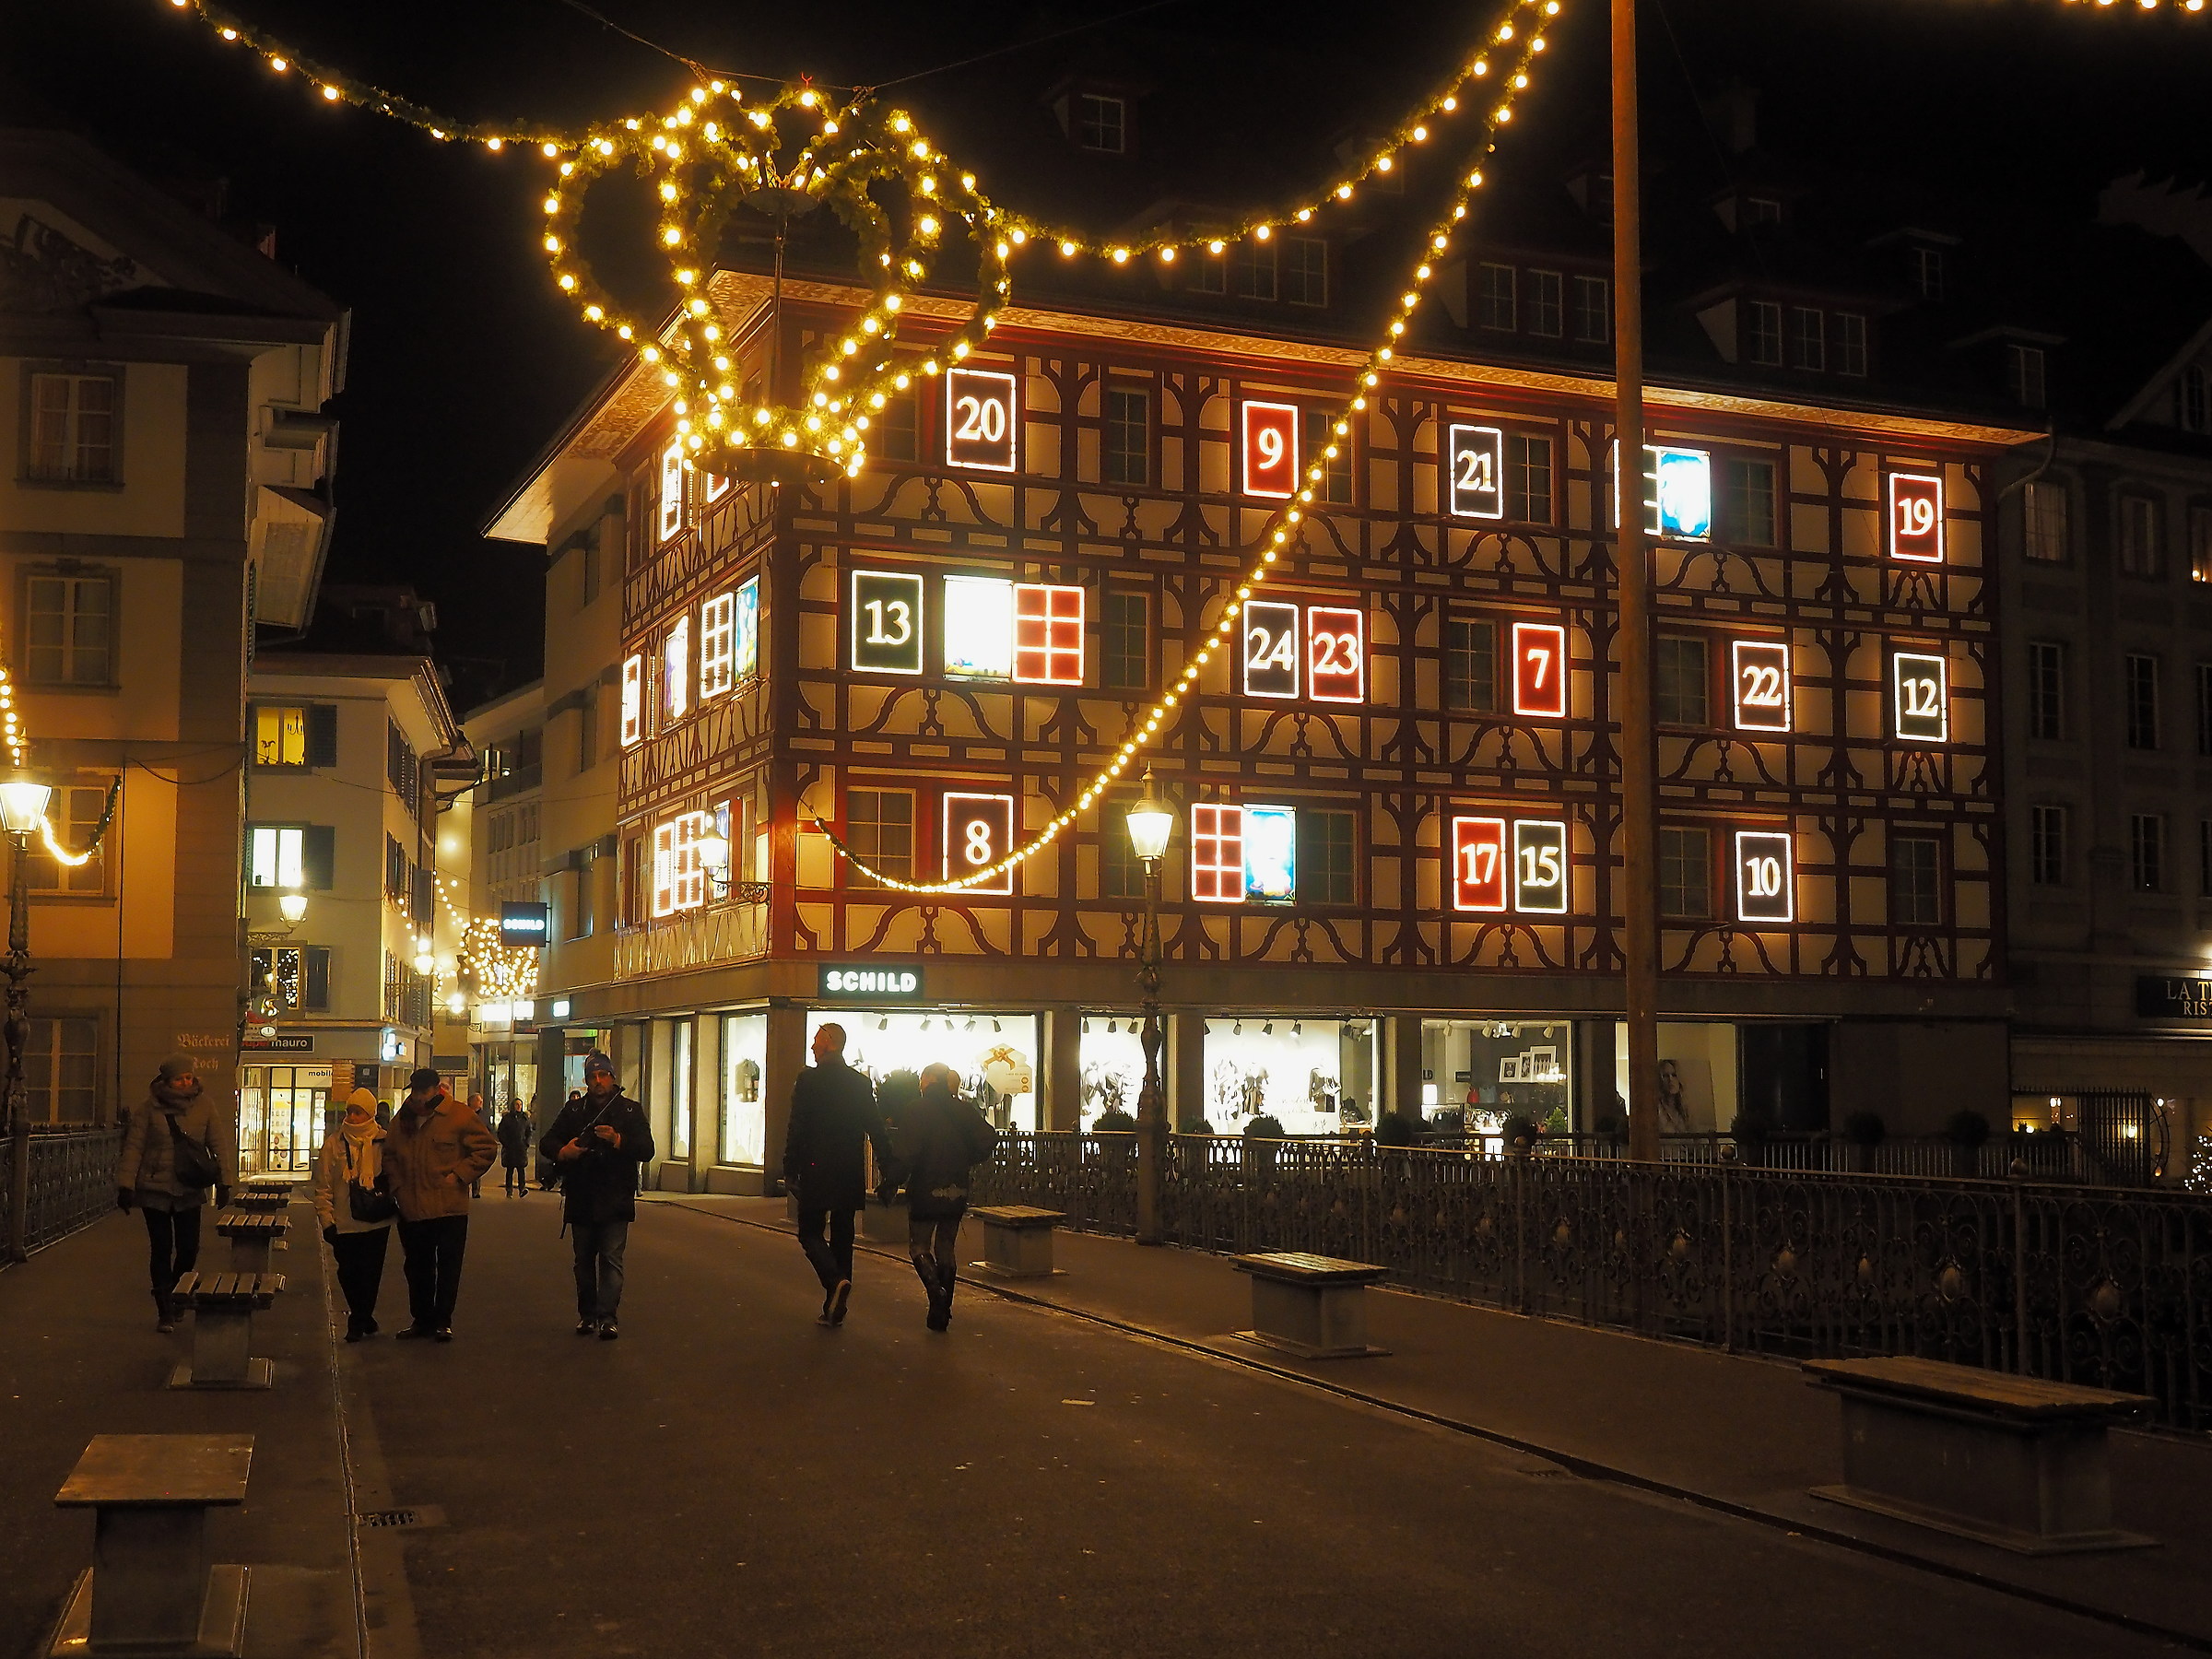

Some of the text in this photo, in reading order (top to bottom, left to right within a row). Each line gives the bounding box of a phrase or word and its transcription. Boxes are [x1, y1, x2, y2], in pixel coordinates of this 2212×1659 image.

[955, 395, 1006, 442] 20
[1258, 427, 1284, 470] 9
[1456, 449, 1497, 493] 21
[1899, 499, 1934, 536] 19
[864, 600, 912, 646] 13
[1248, 626, 1294, 672] 24
[1313, 631, 1359, 676] 23
[1526, 648, 1550, 689] 7
[1742, 665, 1783, 707] 22
[1901, 677, 1938, 718] 12
[964, 819, 992, 865] 8
[1460, 842, 1499, 885] 17
[1520, 845, 1559, 888] 15
[1746, 856, 1781, 896] 10
[827, 971, 917, 993] SCHILD
[2166, 980, 2192, 1000] LA
